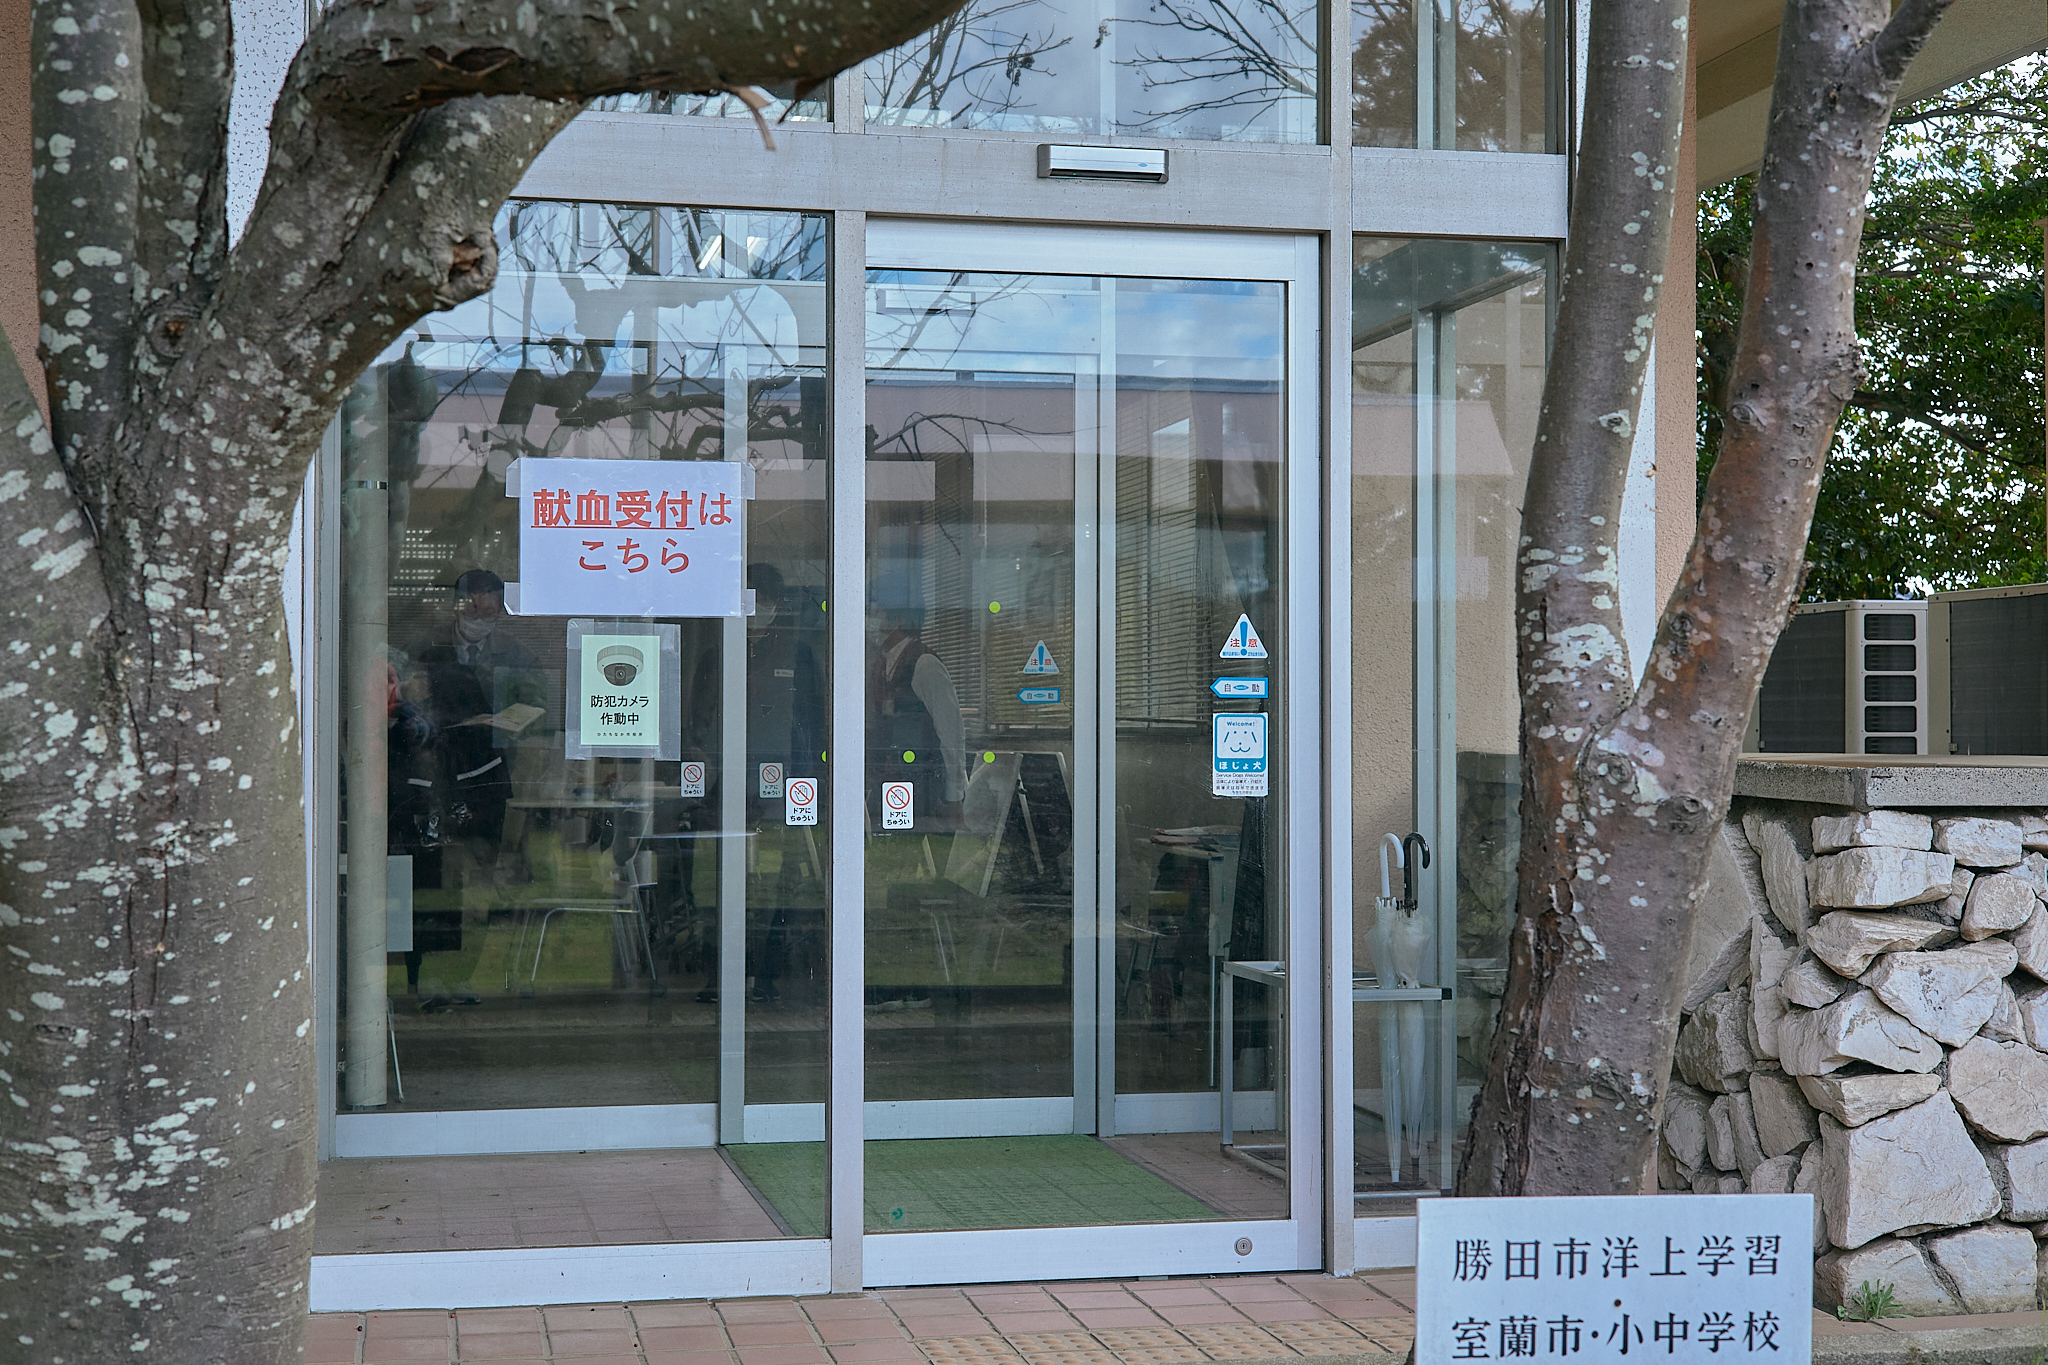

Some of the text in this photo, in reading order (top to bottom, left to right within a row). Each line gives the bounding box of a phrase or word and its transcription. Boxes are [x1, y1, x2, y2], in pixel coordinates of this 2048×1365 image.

[533, 489, 732, 528] 献血受付は
[579, 538, 689, 573] こちら
[590, 695, 650, 708] 防犯カメラ
[600, 712, 640, 725] 作動中
[1218, 761, 1262, 770] ほじょ犬
[1452, 1235, 1782, 1283] 勝田市洋上学習
[1452, 1310, 1781, 1360] 室蘭市・小中学校
